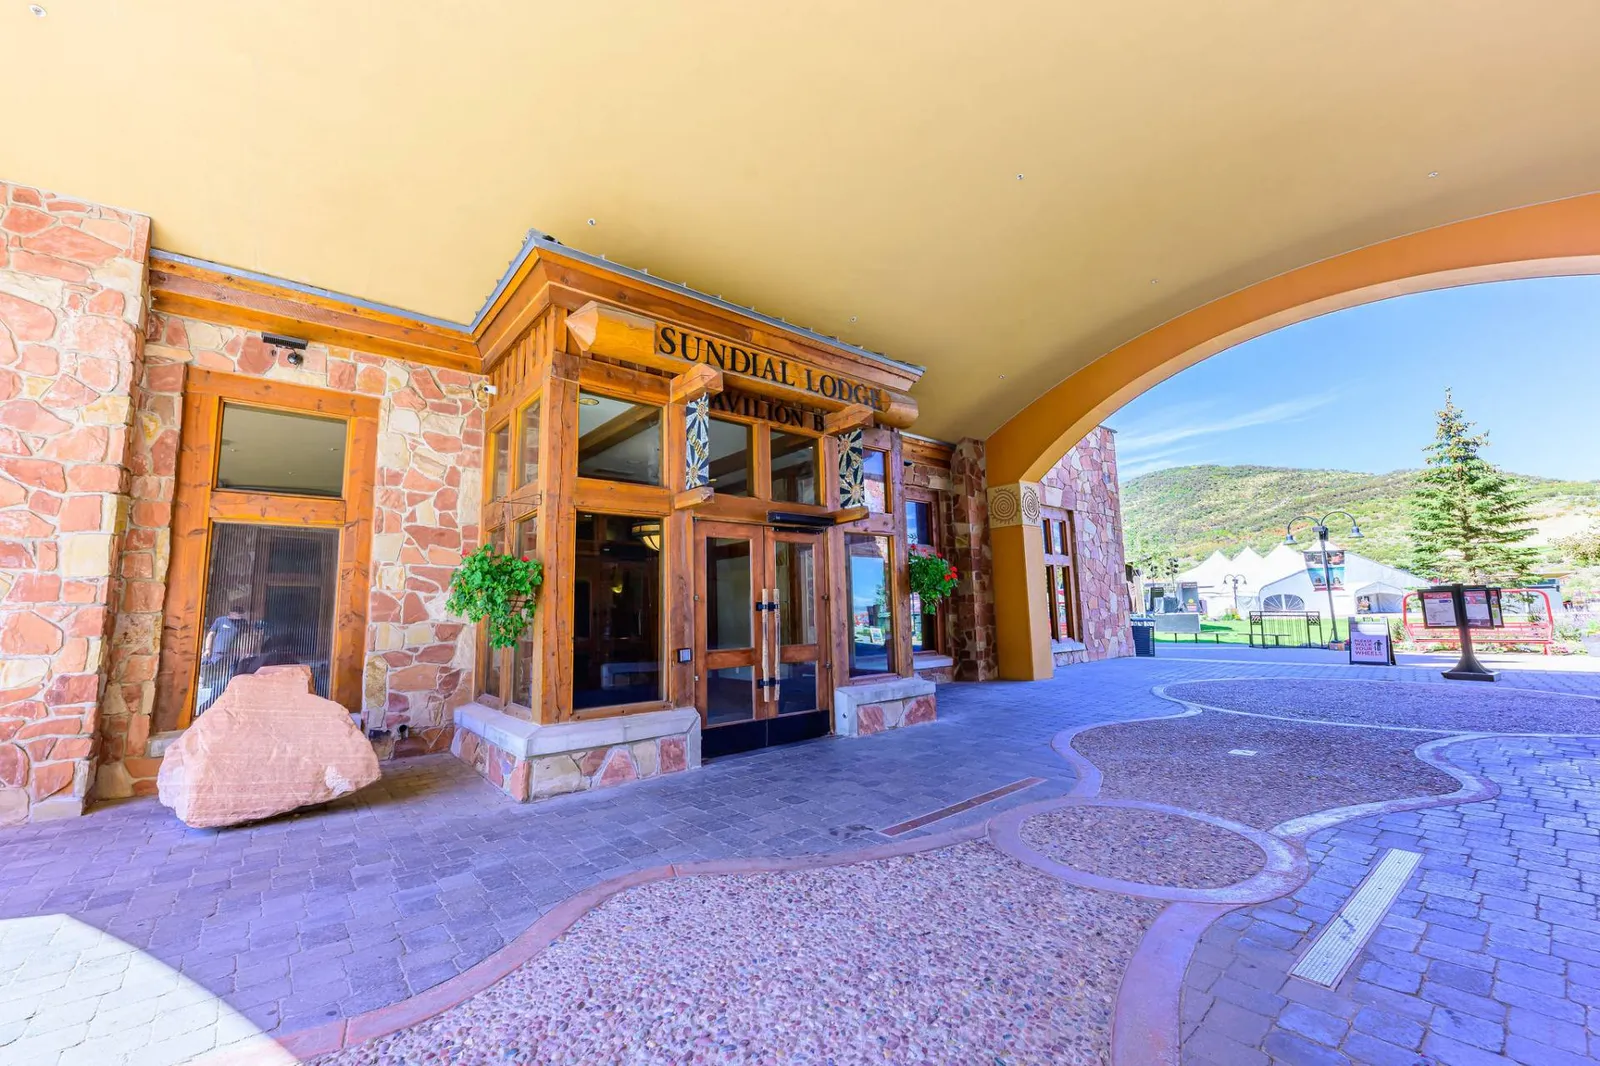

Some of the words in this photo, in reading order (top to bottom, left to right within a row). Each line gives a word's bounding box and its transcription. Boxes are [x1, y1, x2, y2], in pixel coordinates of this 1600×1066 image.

[659, 327, 795, 386] SUNDIAL
[805, 368, 882, 408] LODGE
[711, 391, 804, 428] AVILION
